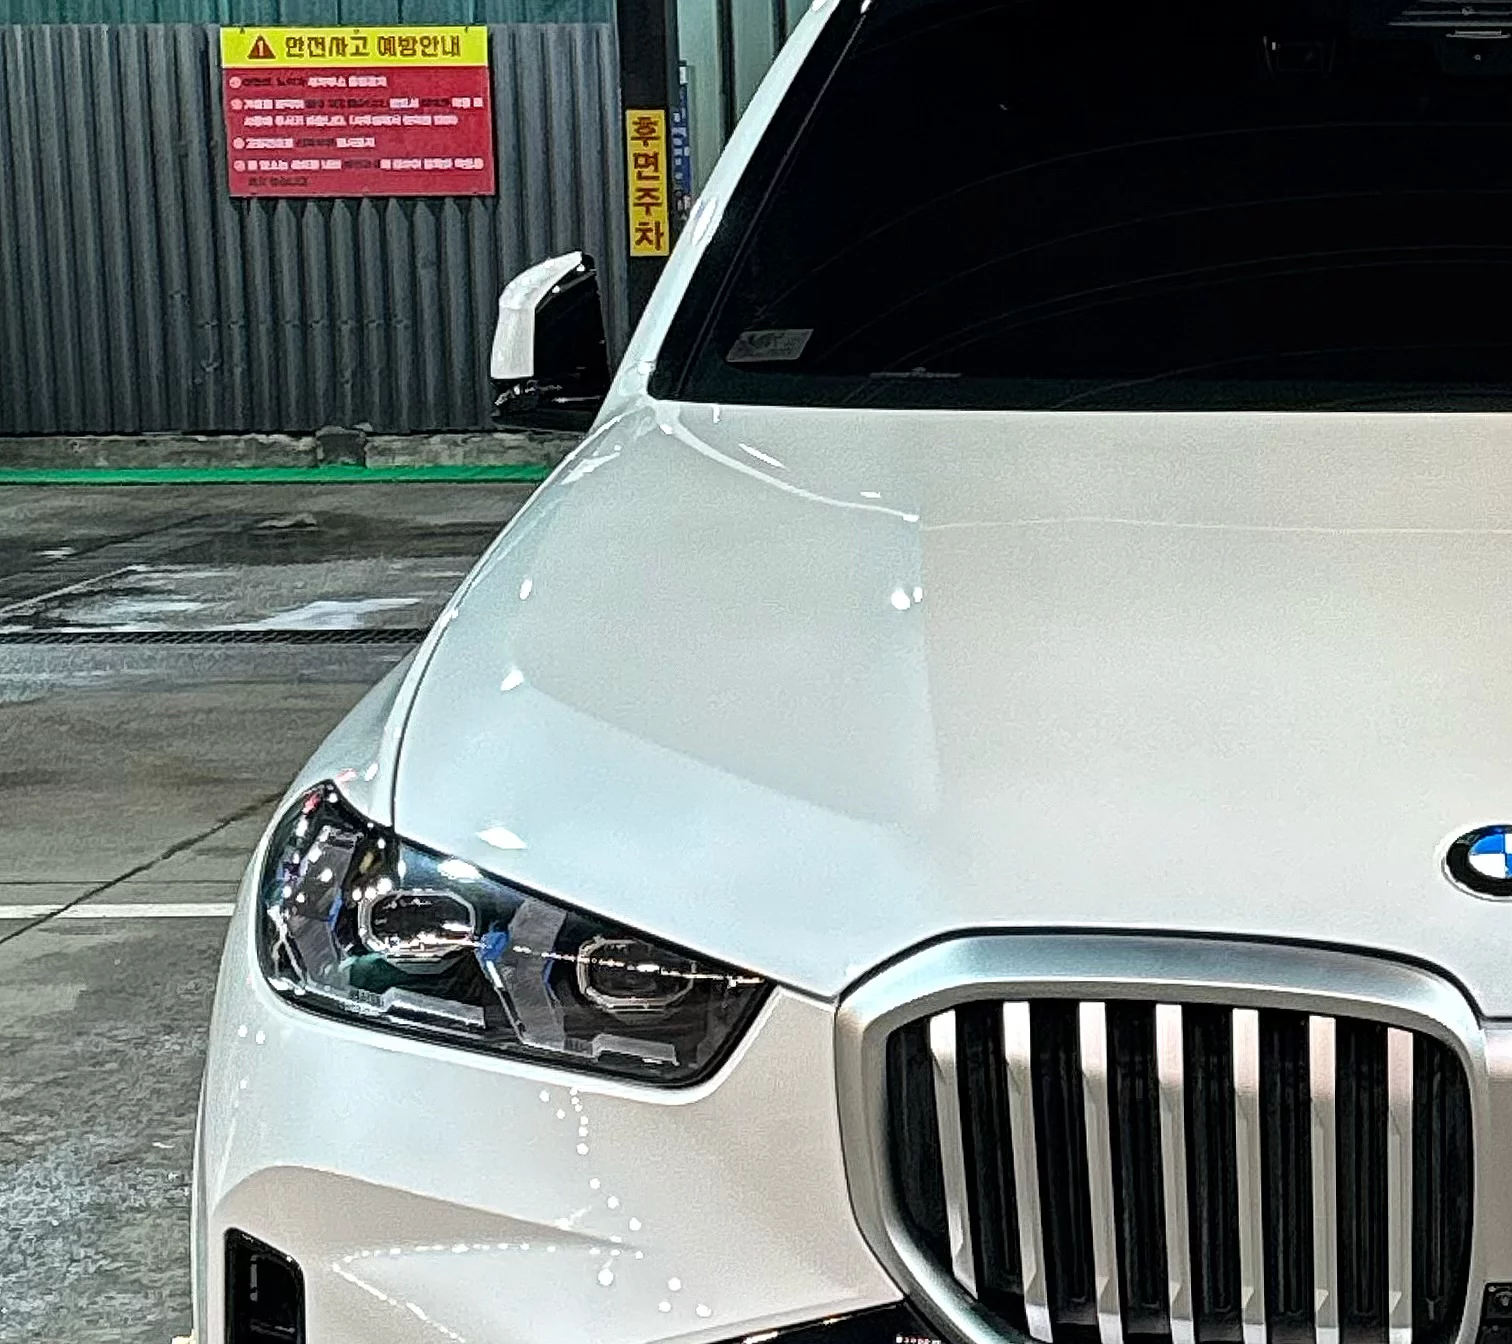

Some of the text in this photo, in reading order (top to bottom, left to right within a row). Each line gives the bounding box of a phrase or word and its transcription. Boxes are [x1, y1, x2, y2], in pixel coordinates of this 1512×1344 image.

[285, 34, 461, 58] 안전사고 예방안내
[631, 116, 664, 251] 후면주차
